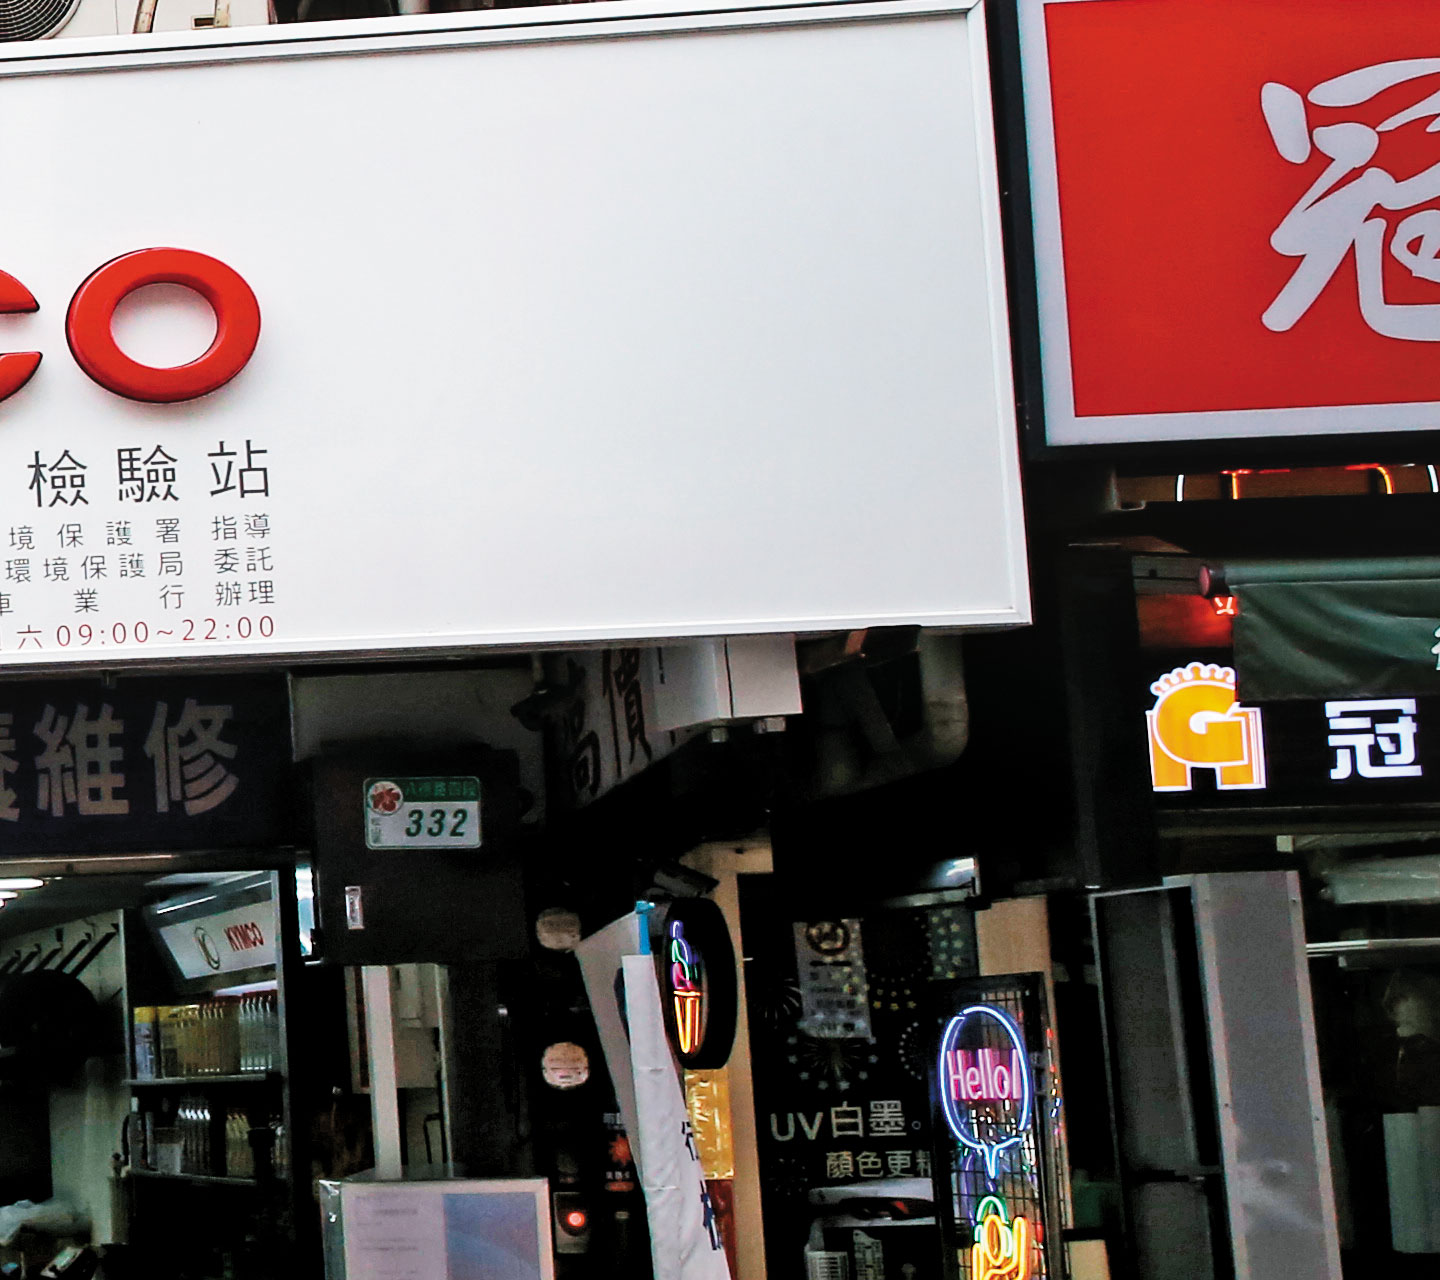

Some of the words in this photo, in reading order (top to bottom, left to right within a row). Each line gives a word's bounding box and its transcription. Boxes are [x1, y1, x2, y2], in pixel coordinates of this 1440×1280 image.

[211, 514, 272, 542] 指導
[214, 546, 275, 574] 委託
[216, 580, 276, 607] 辦理
[1324, 697, 1423, 780] 冠
[405, 808, 468, 837] 332
